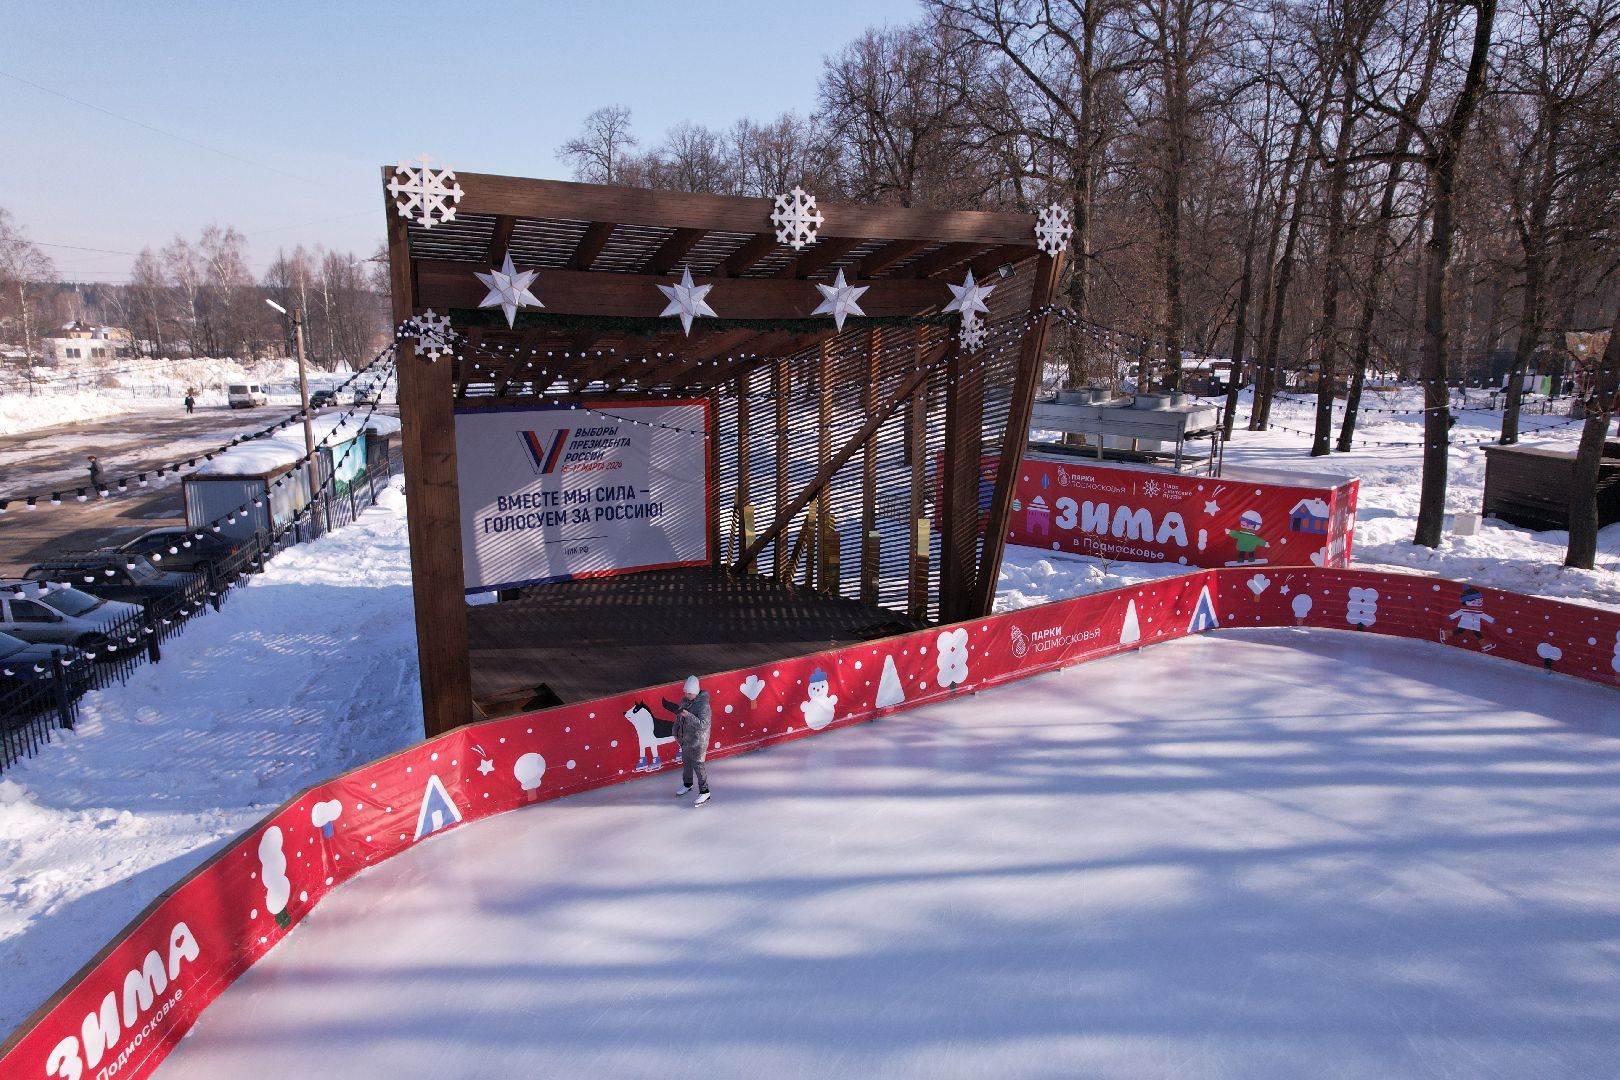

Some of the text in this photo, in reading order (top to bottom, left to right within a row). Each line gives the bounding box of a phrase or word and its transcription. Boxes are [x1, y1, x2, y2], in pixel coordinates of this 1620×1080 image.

[575, 426, 619, 438] ВЫБОРЫ
[569, 437, 631, 450] ПРЕЗИДЕНТА
[564, 451, 604, 463] РОССИИ
[581, 462, 605, 472] МАРТА
[1071, 474, 1095, 482] ПАРКИ
[497, 491, 559, 511] ВМЕСТЕ
[564, 488, 591, 505] МЫ
[595, 485, 636, 501] СИЛА
[484, 502, 663, 533] ГОЛОСУЕМ ЗА РОССИЮ!
[1055, 496, 1188, 547] ЗИМА
[1073, 537, 1164, 559] в Подмосковье
[1031, 626, 1062, 641] ПАРКИ
[1031, 628, 1100, 653] ПОДМОСКОВЬЯ
[46, 922, 200, 1080] ЗИМА
[96, 989, 183, 1080] Подмосковье
